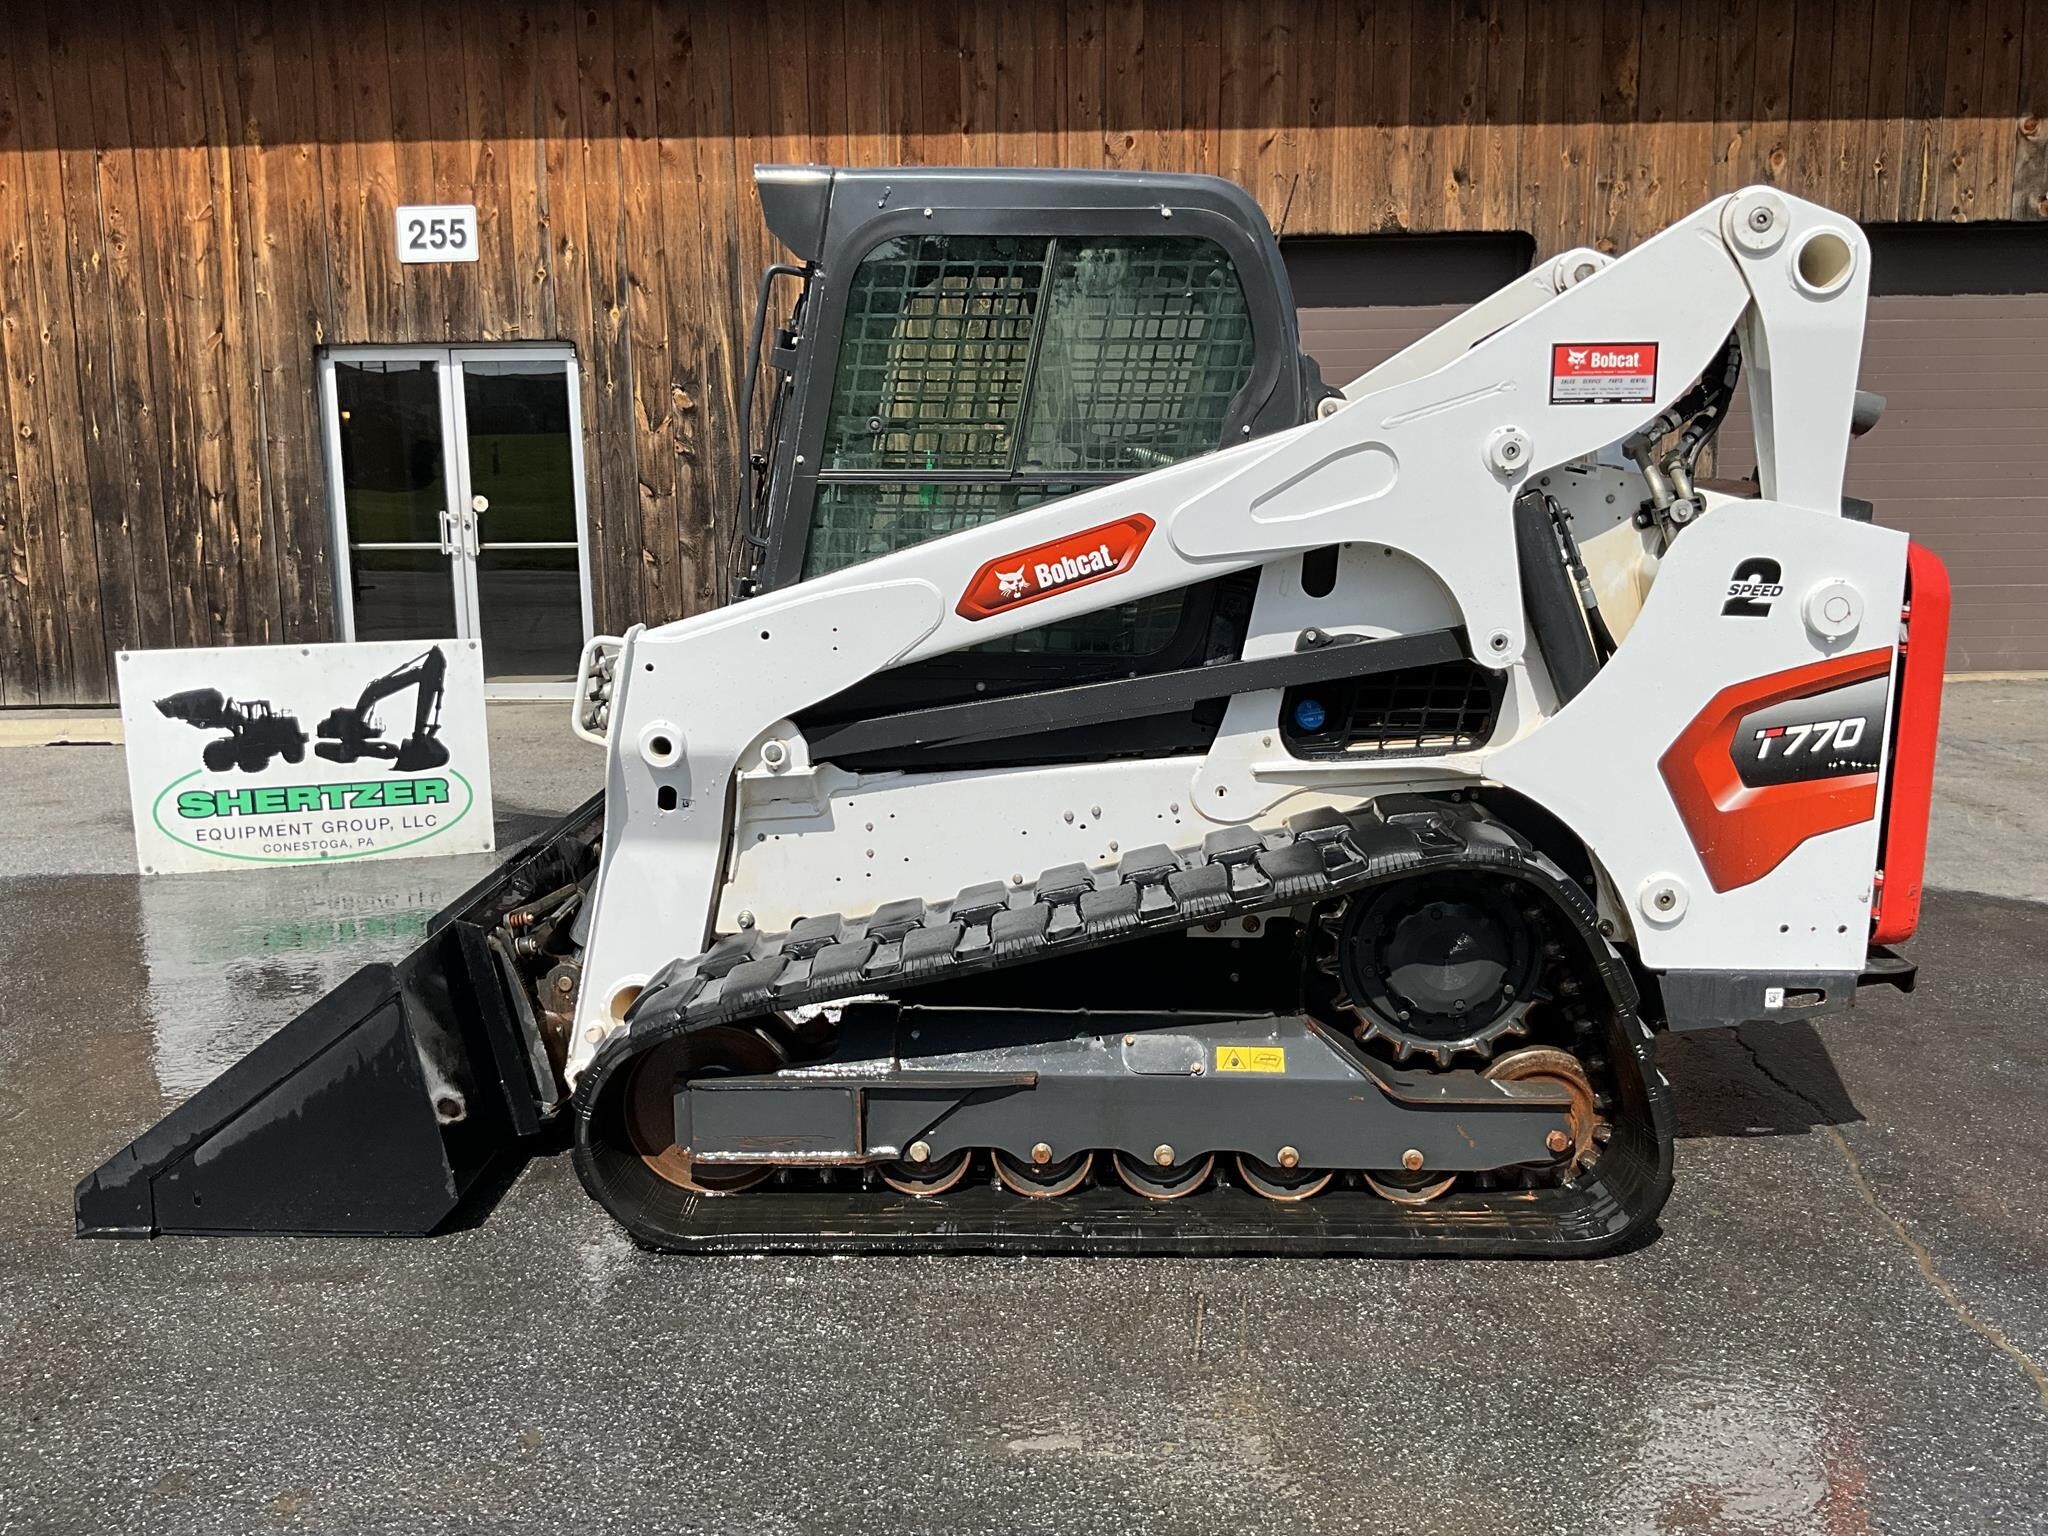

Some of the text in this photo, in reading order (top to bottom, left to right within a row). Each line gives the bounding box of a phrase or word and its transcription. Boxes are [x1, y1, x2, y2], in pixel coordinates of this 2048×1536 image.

[408, 219, 467, 249] 255
[1590, 352, 1640, 368] Bobcat
[1034, 544, 1115, 589] Bobcat
[1720, 557, 1782, 617] 2
[1727, 583, 1784, 597] SPEED
[1755, 717, 1867, 760] T770
[178, 778, 449, 819] SHERTZER
[196, 814, 438, 841] EQUIPMENT GROUP, LLC
[263, 838, 375, 854] CONESTOGA, PA
